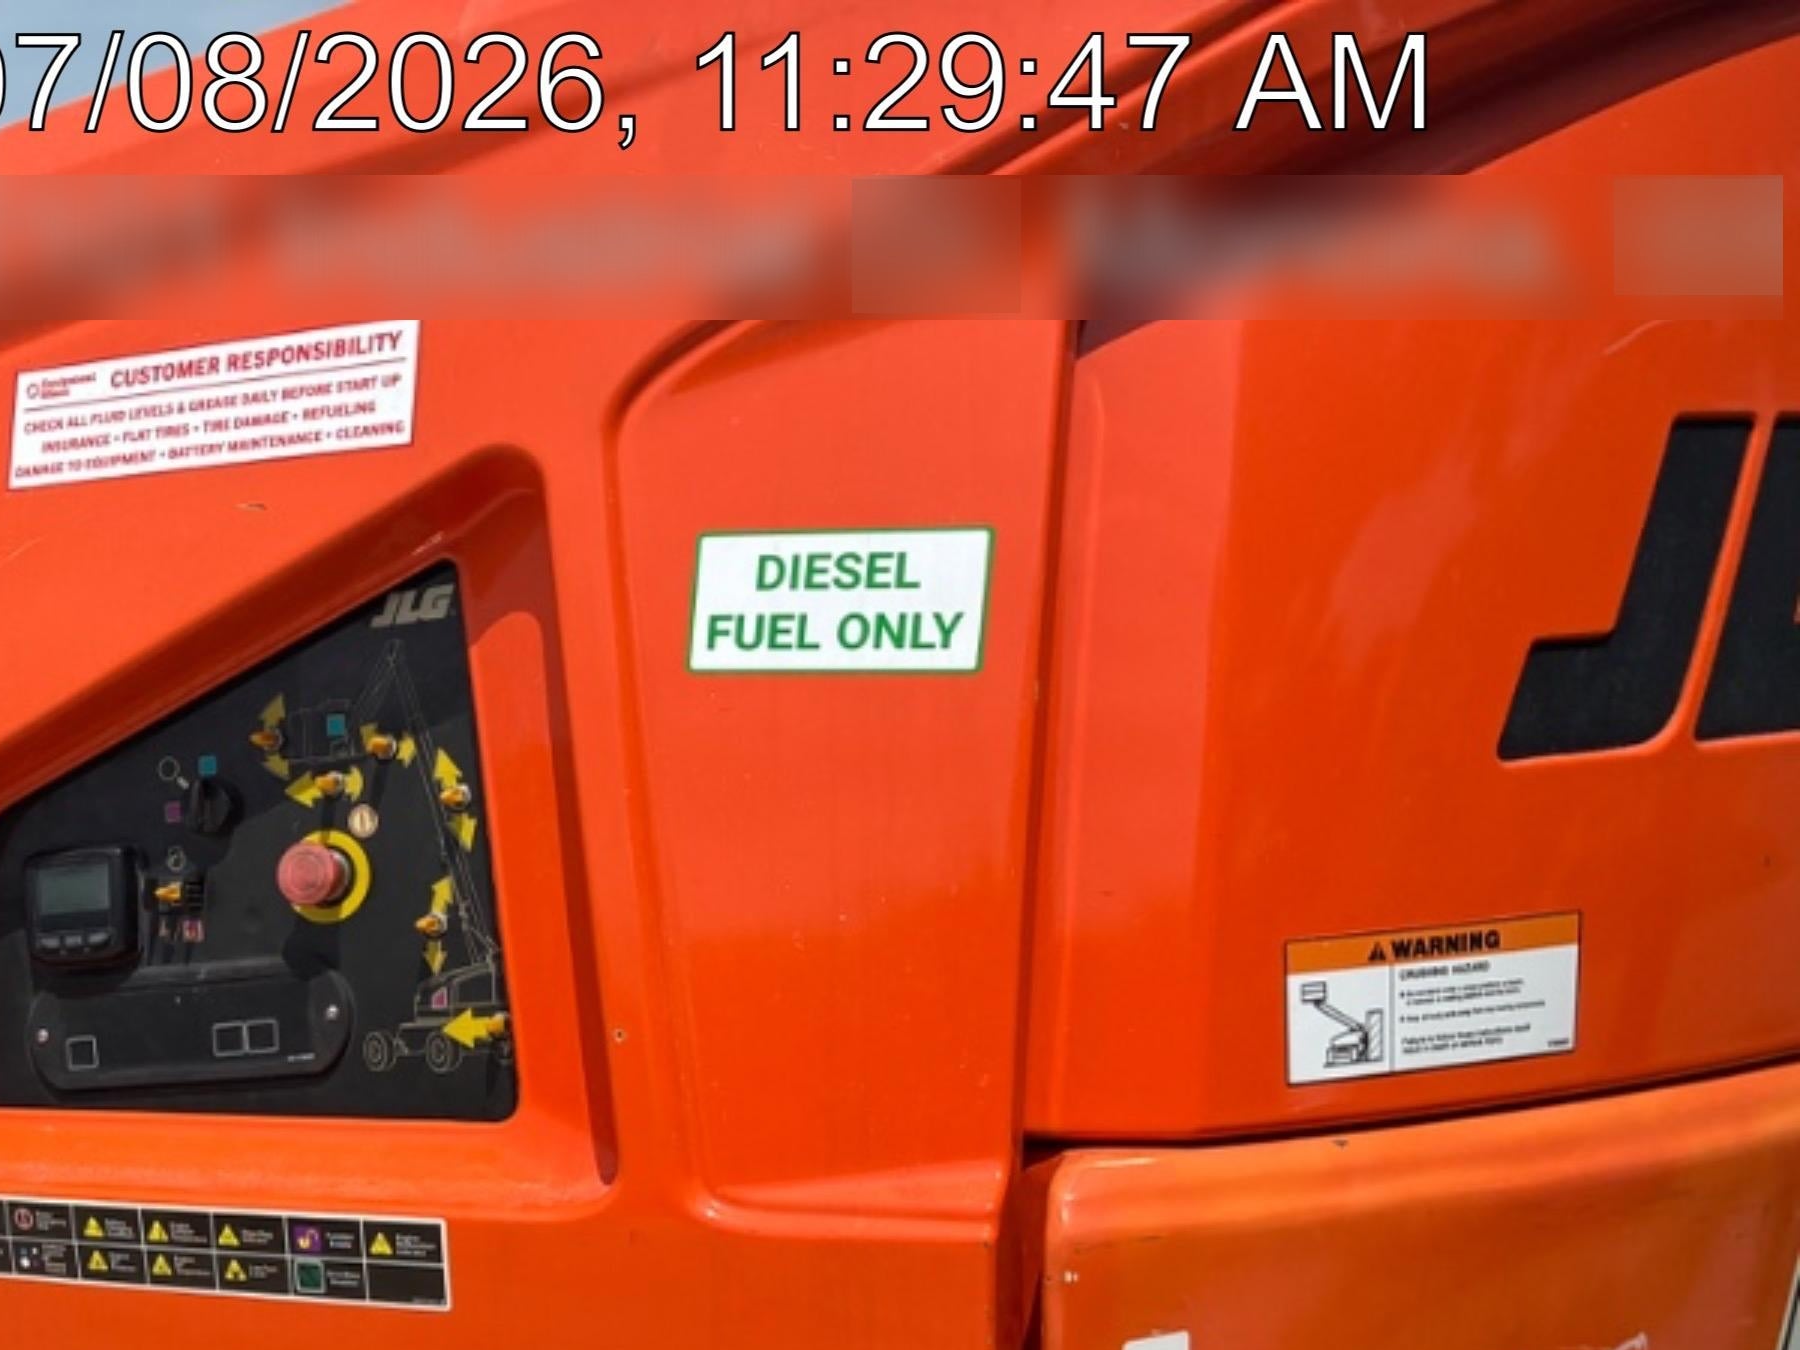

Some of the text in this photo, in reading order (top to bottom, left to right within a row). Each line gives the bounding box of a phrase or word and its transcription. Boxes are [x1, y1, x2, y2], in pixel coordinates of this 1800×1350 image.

[110, 329, 403, 388] CUSTOMER RESPONSIBILITY
[24, 416, 63, 435] CHECK
[67, 414, 88, 428] ALL
[91, 410, 126, 425] FLUID
[129, 402, 173, 421] LEVELS
[189, 395, 238, 413] GREASE
[242, 389, 278, 406] DAILY
[282, 382, 333, 400] BEFORE
[336, 374, 378, 393] START
[380, 373, 402, 388] UP
[42, 401, 376, 453] INSURANCE FLAT TIRES TIRE DAMAGE REFUELING
[15, 420, 405, 478] DAMAGE TO EQUIPMENT BATTERY MAINTENANCE CLEANING
[755, 551, 921, 591] DIESEL
[370, 583, 454, 628] JLG
[706, 611, 964, 650] FUEL ONLY
[1390, 929, 1500, 960] WARNING
